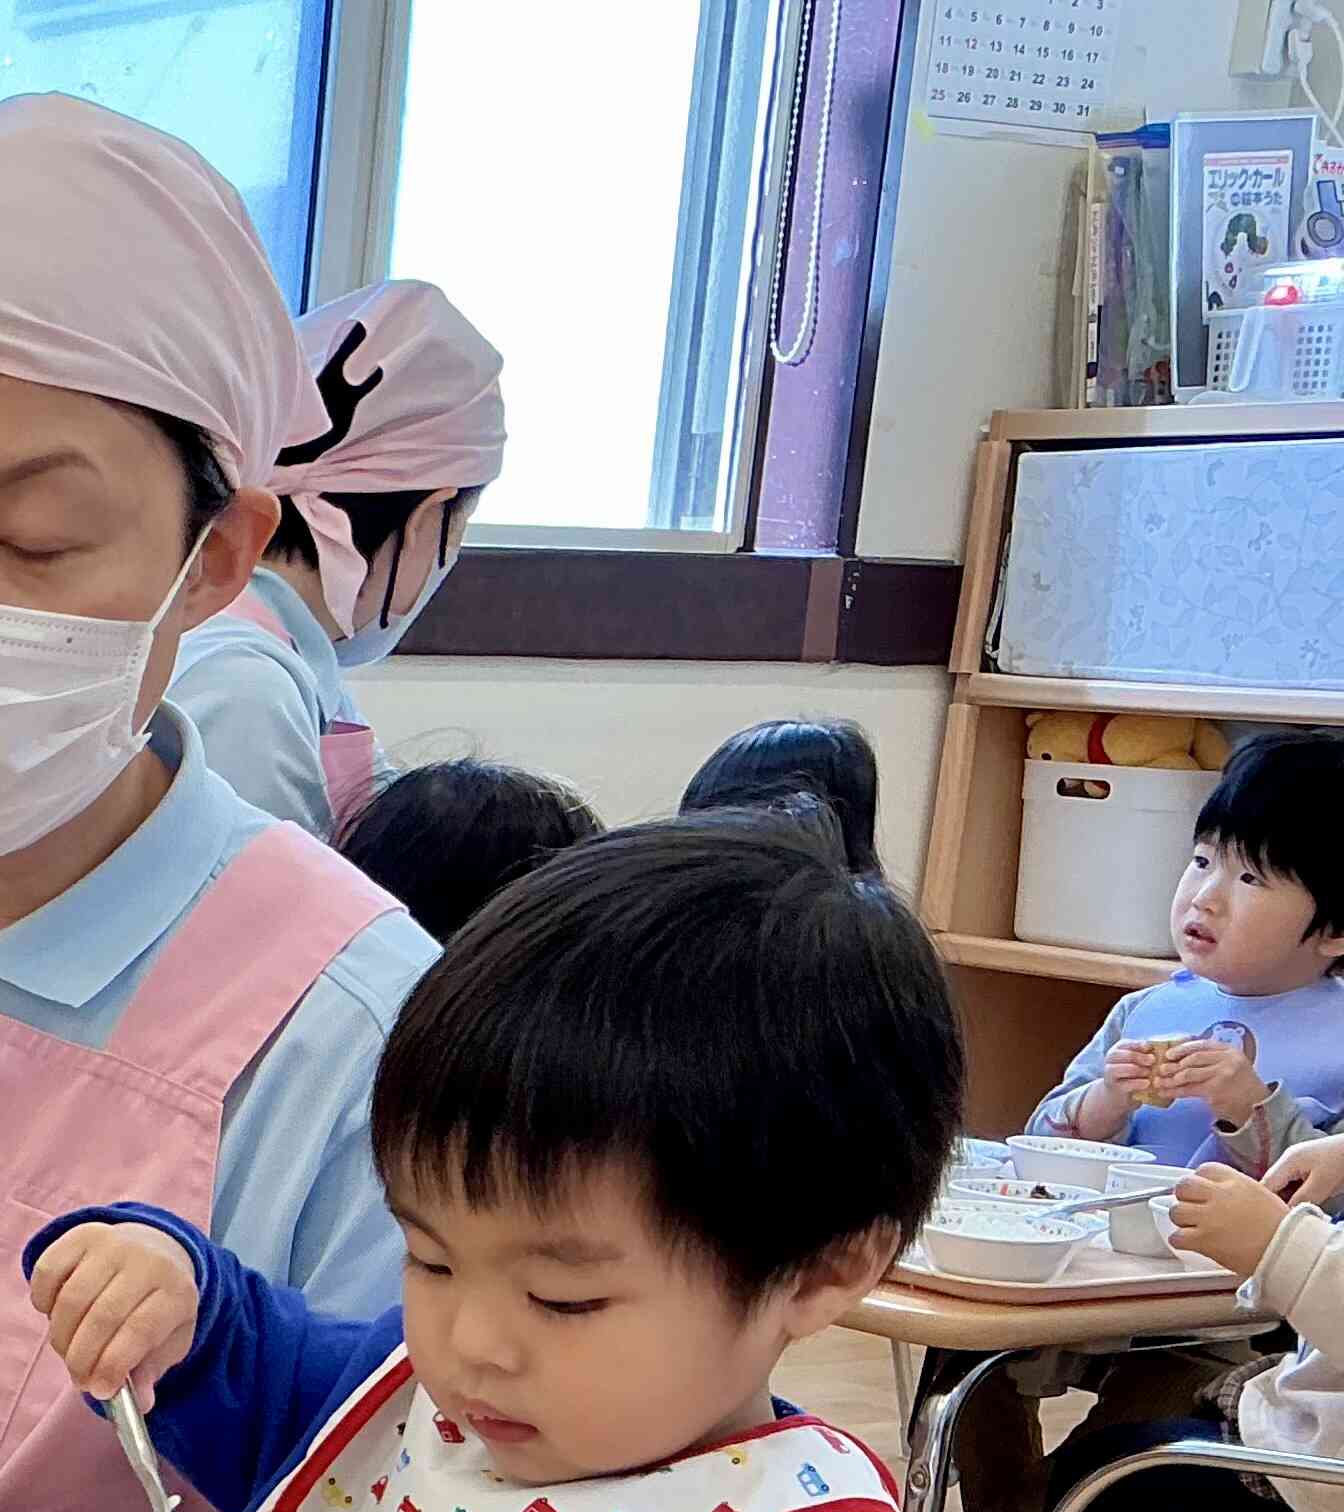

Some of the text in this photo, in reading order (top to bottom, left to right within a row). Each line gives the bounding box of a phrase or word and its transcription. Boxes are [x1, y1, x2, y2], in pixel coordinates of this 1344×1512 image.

[1096, 0, 1103, 11] 3
[945, 8, 1103, 36] 4 5 6 7 8 9 10
[940, 36, 1098, 63] 11 12 13 14 15 16 17
[935, 62, 1094, 89] 18 19 20 21 22 23 24
[931, 88, 1089, 117] 25 26 27 28 29 30 31
